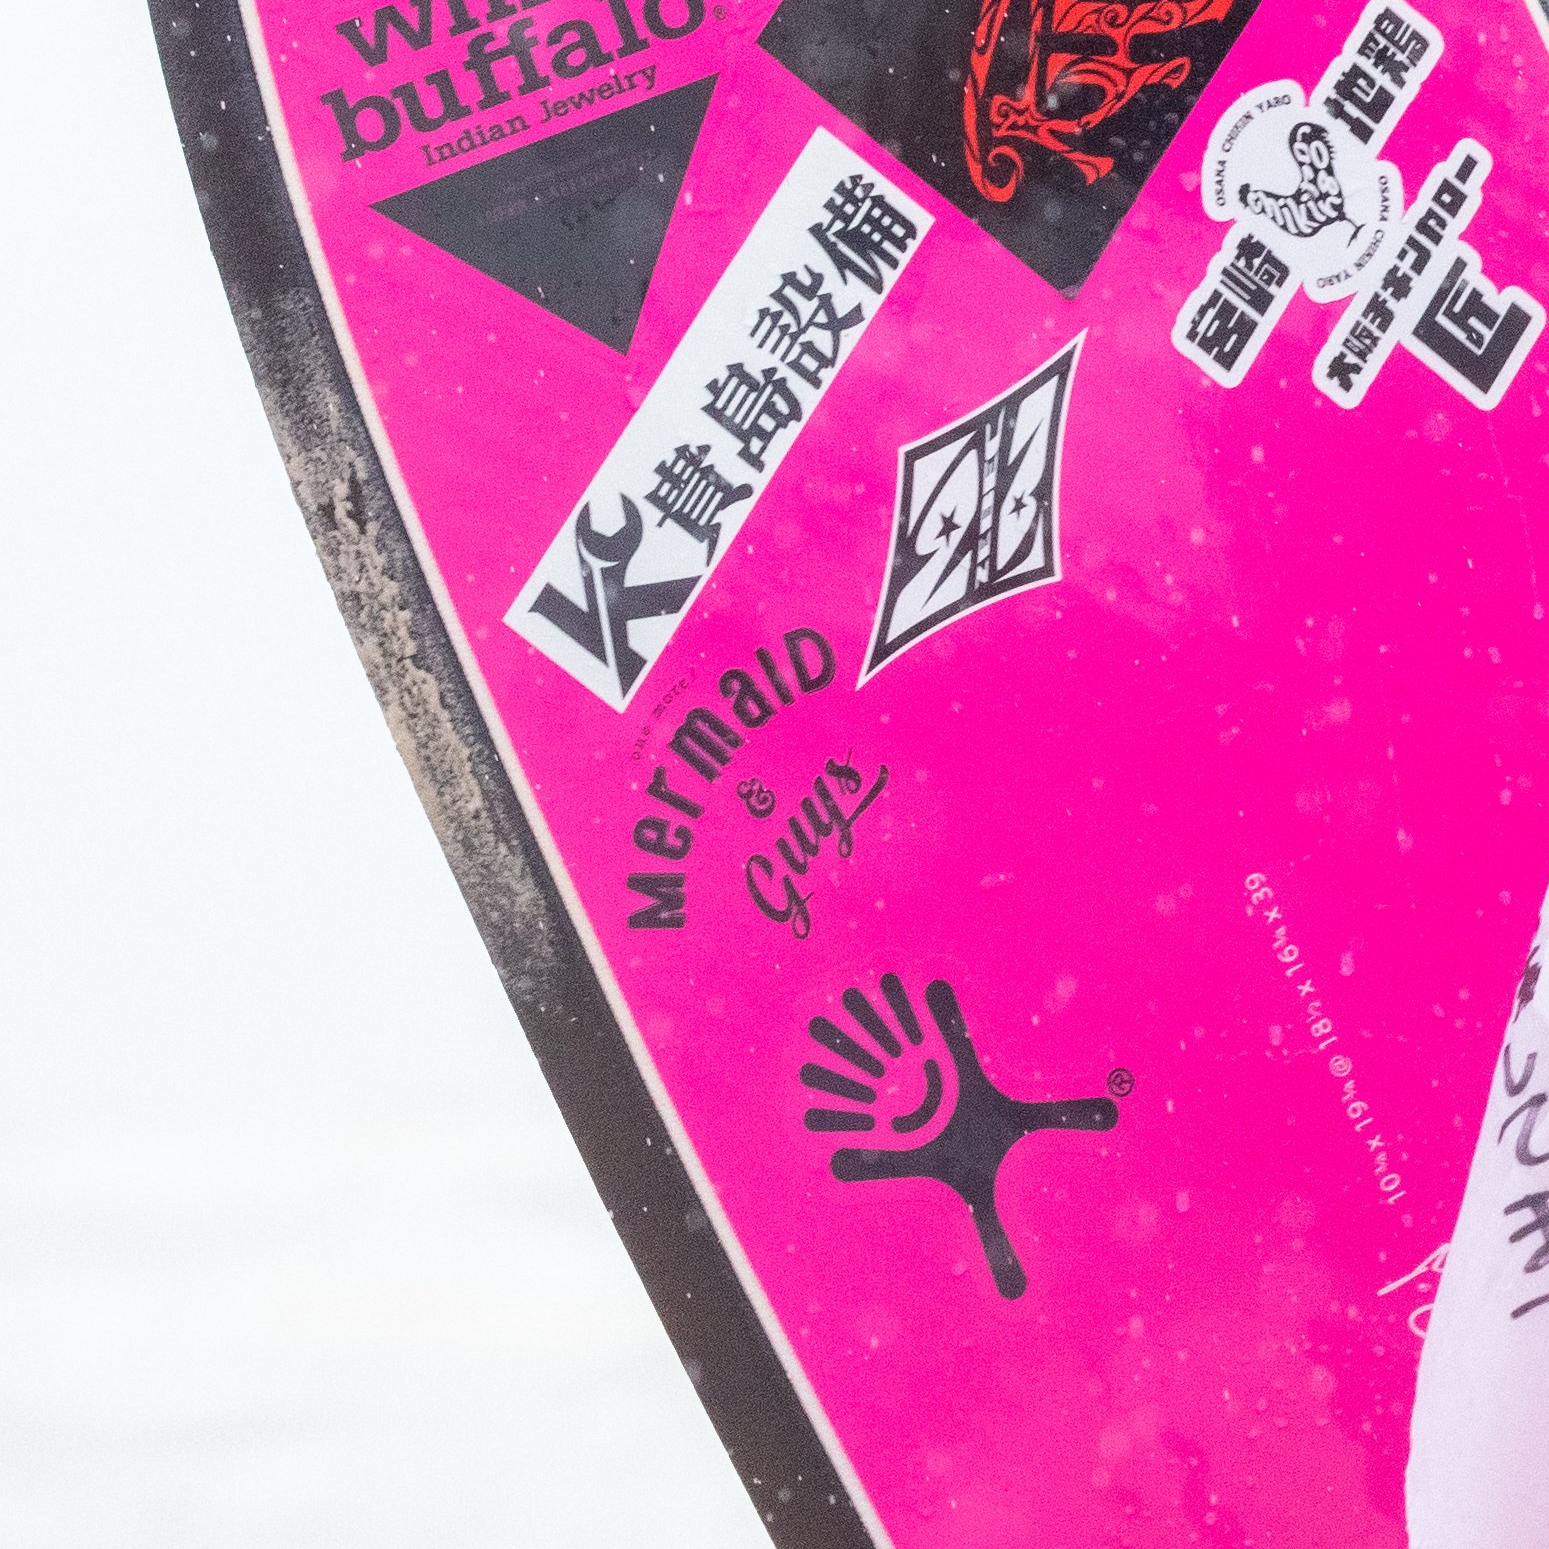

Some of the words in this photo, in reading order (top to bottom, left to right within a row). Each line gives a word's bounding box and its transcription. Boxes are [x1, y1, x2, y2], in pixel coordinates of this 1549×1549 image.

[422, 113, 529, 166] Indian
[537, 64, 660, 126] Jewelry
[1412, 256, 1532, 395] 匠
[736, 778, 777, 819] &
[746, 747, 890, 940] Guys
[1243, 872, 1273, 906] 39
